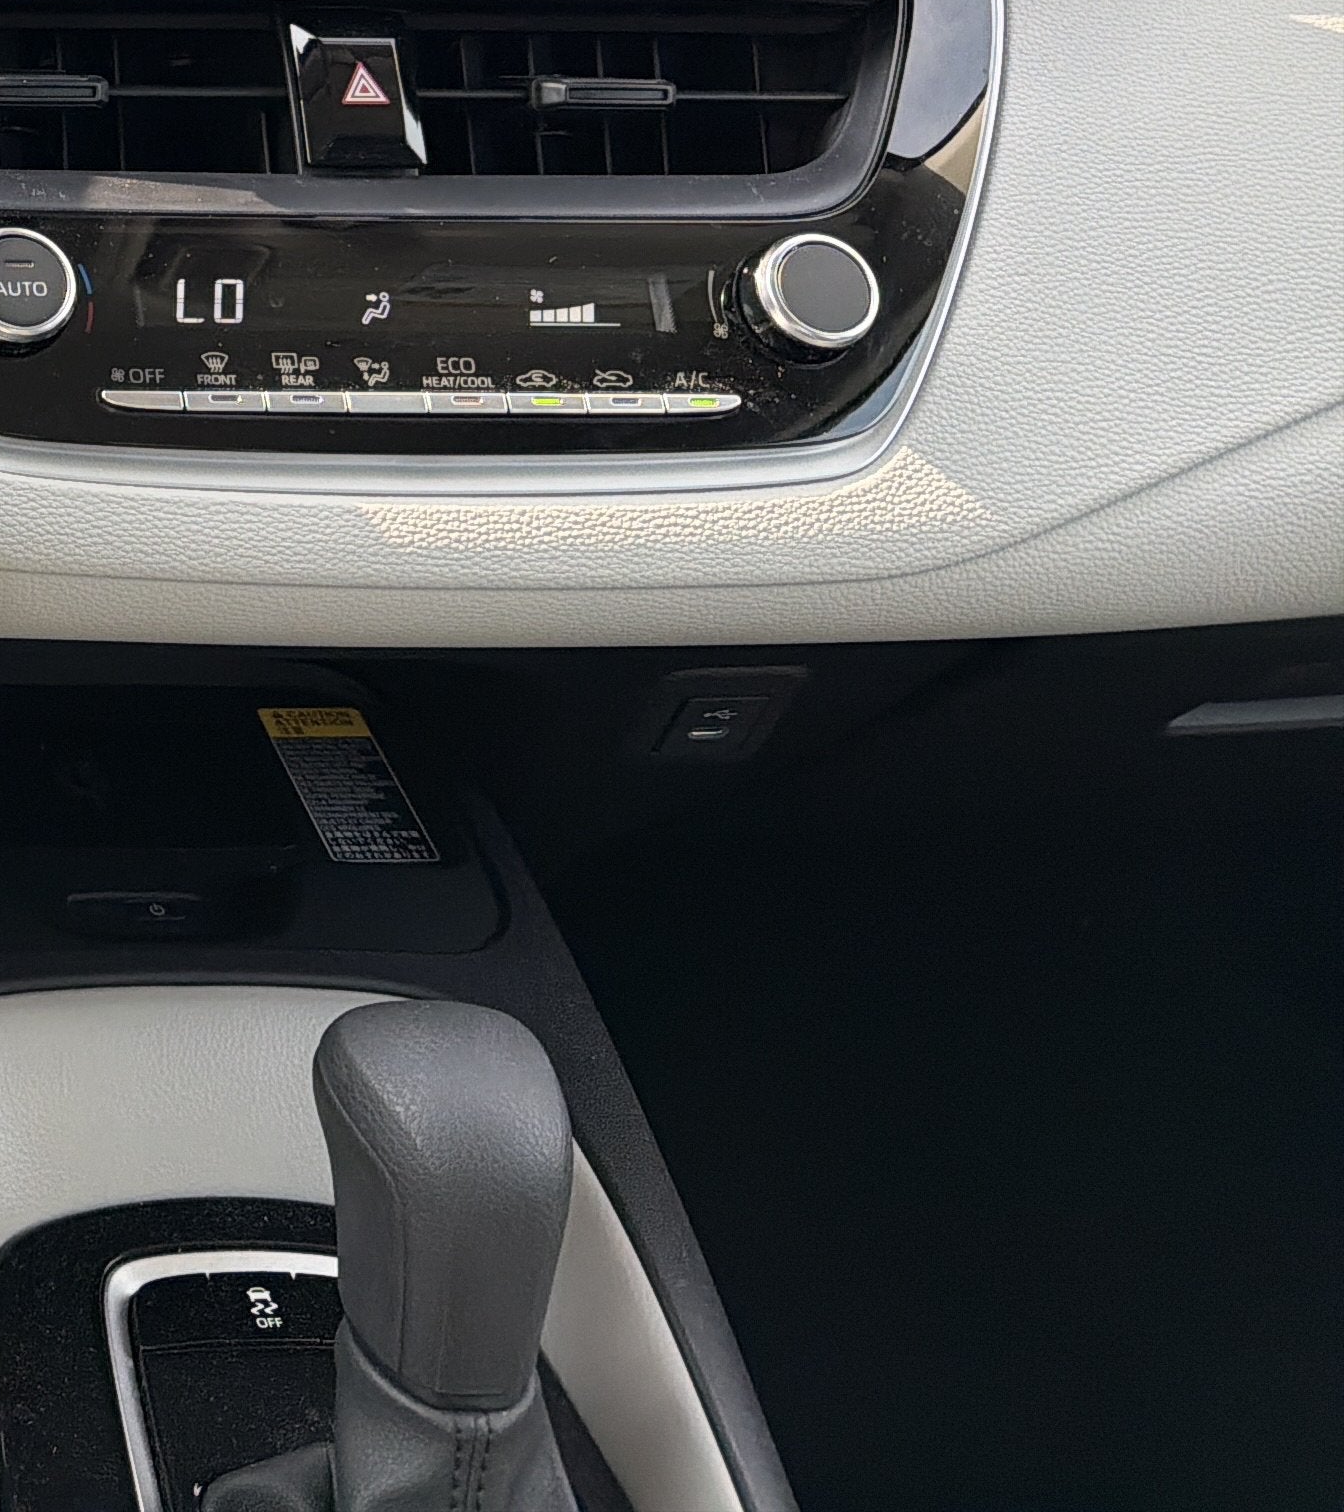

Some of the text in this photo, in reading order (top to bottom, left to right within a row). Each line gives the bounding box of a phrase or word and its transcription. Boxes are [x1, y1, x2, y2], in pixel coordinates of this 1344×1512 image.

[176, 278, 244, 324] LO
[437, 357, 476, 374] ECO
[129, 368, 165, 384] OFF
[197, 374, 236, 386] FRONT
[281, 375, 315, 386] REAR
[422, 375, 495, 389] HEAT/COOL
[674, 370, 710, 388] A/C
[256, 1317, 284, 1328] OFF
